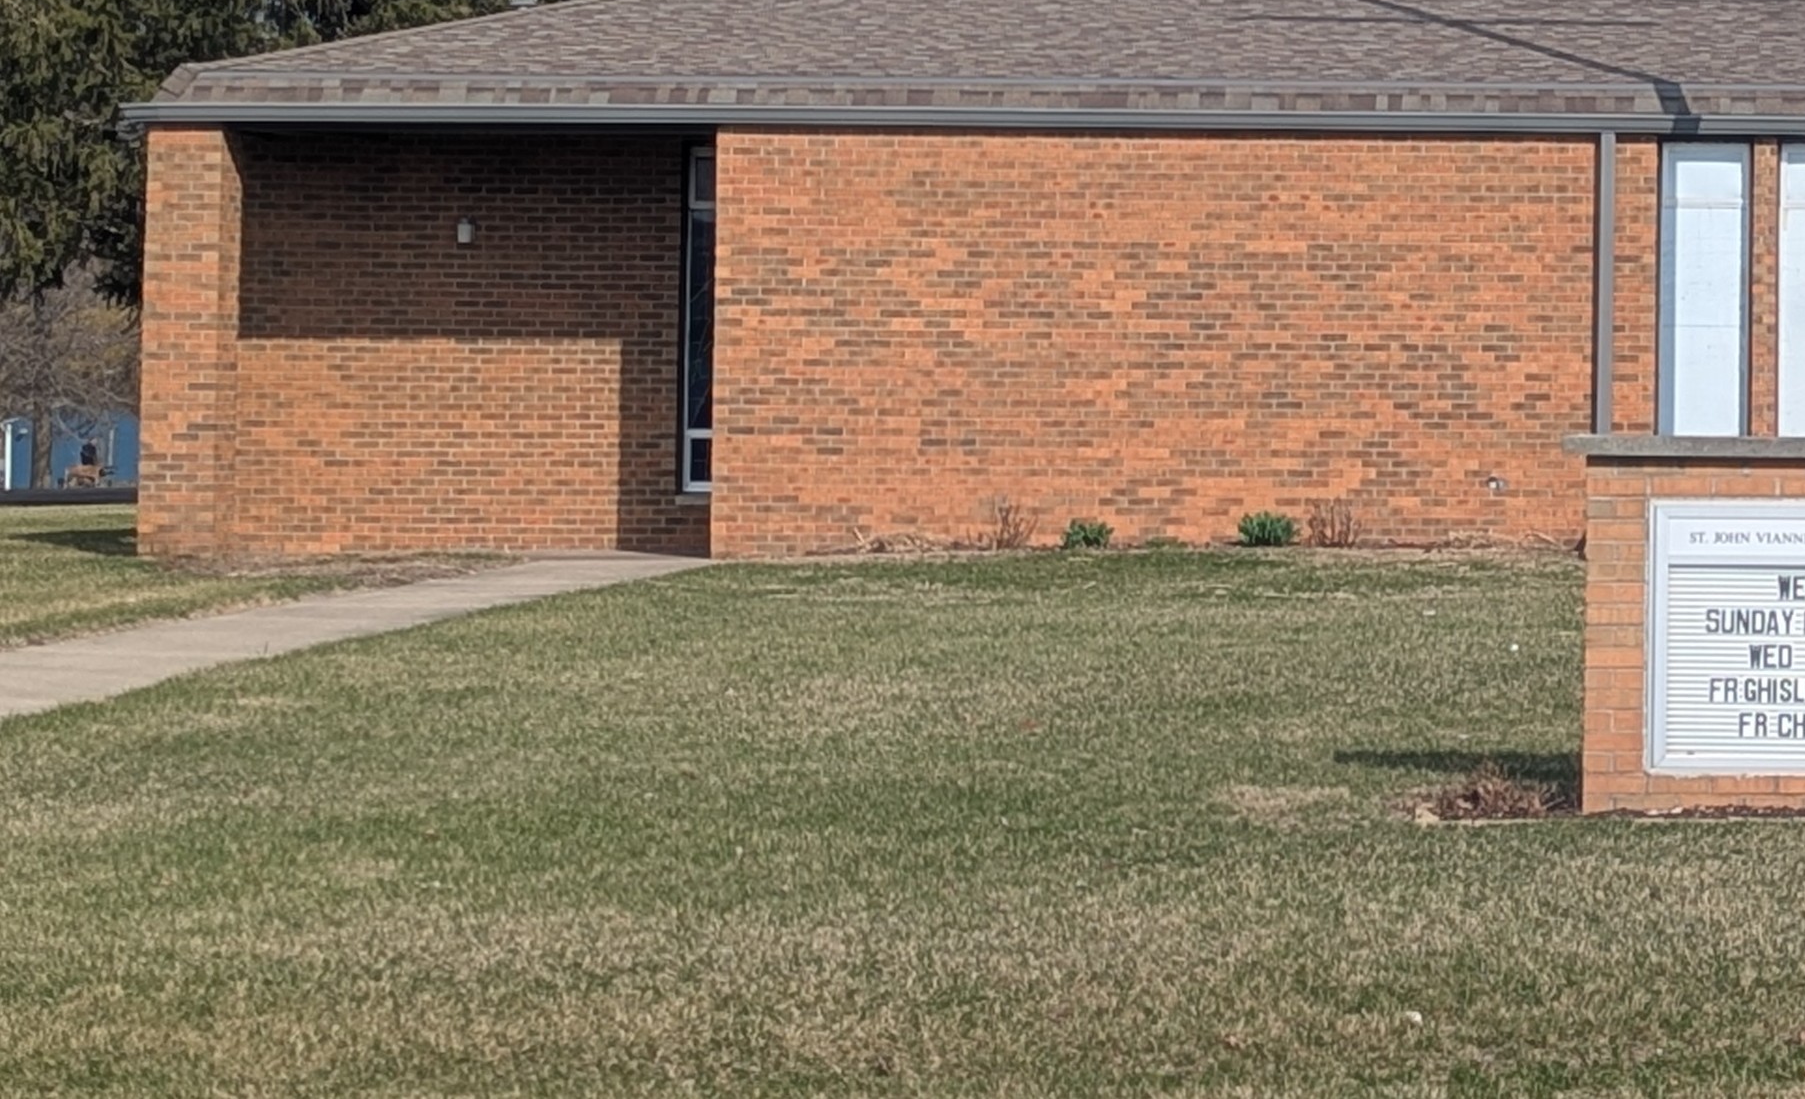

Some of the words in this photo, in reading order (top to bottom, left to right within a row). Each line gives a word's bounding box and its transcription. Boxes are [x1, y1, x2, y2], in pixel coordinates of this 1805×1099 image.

[1689, 532, 1709, 545] ST.
[1713, 532, 1751, 545] JOHN
[1705, 609, 1794, 635] SUNDAY
[1749, 644, 1792, 669] WED
[1709, 678, 1738, 703] FR
[1739, 712, 1767, 738] FR
